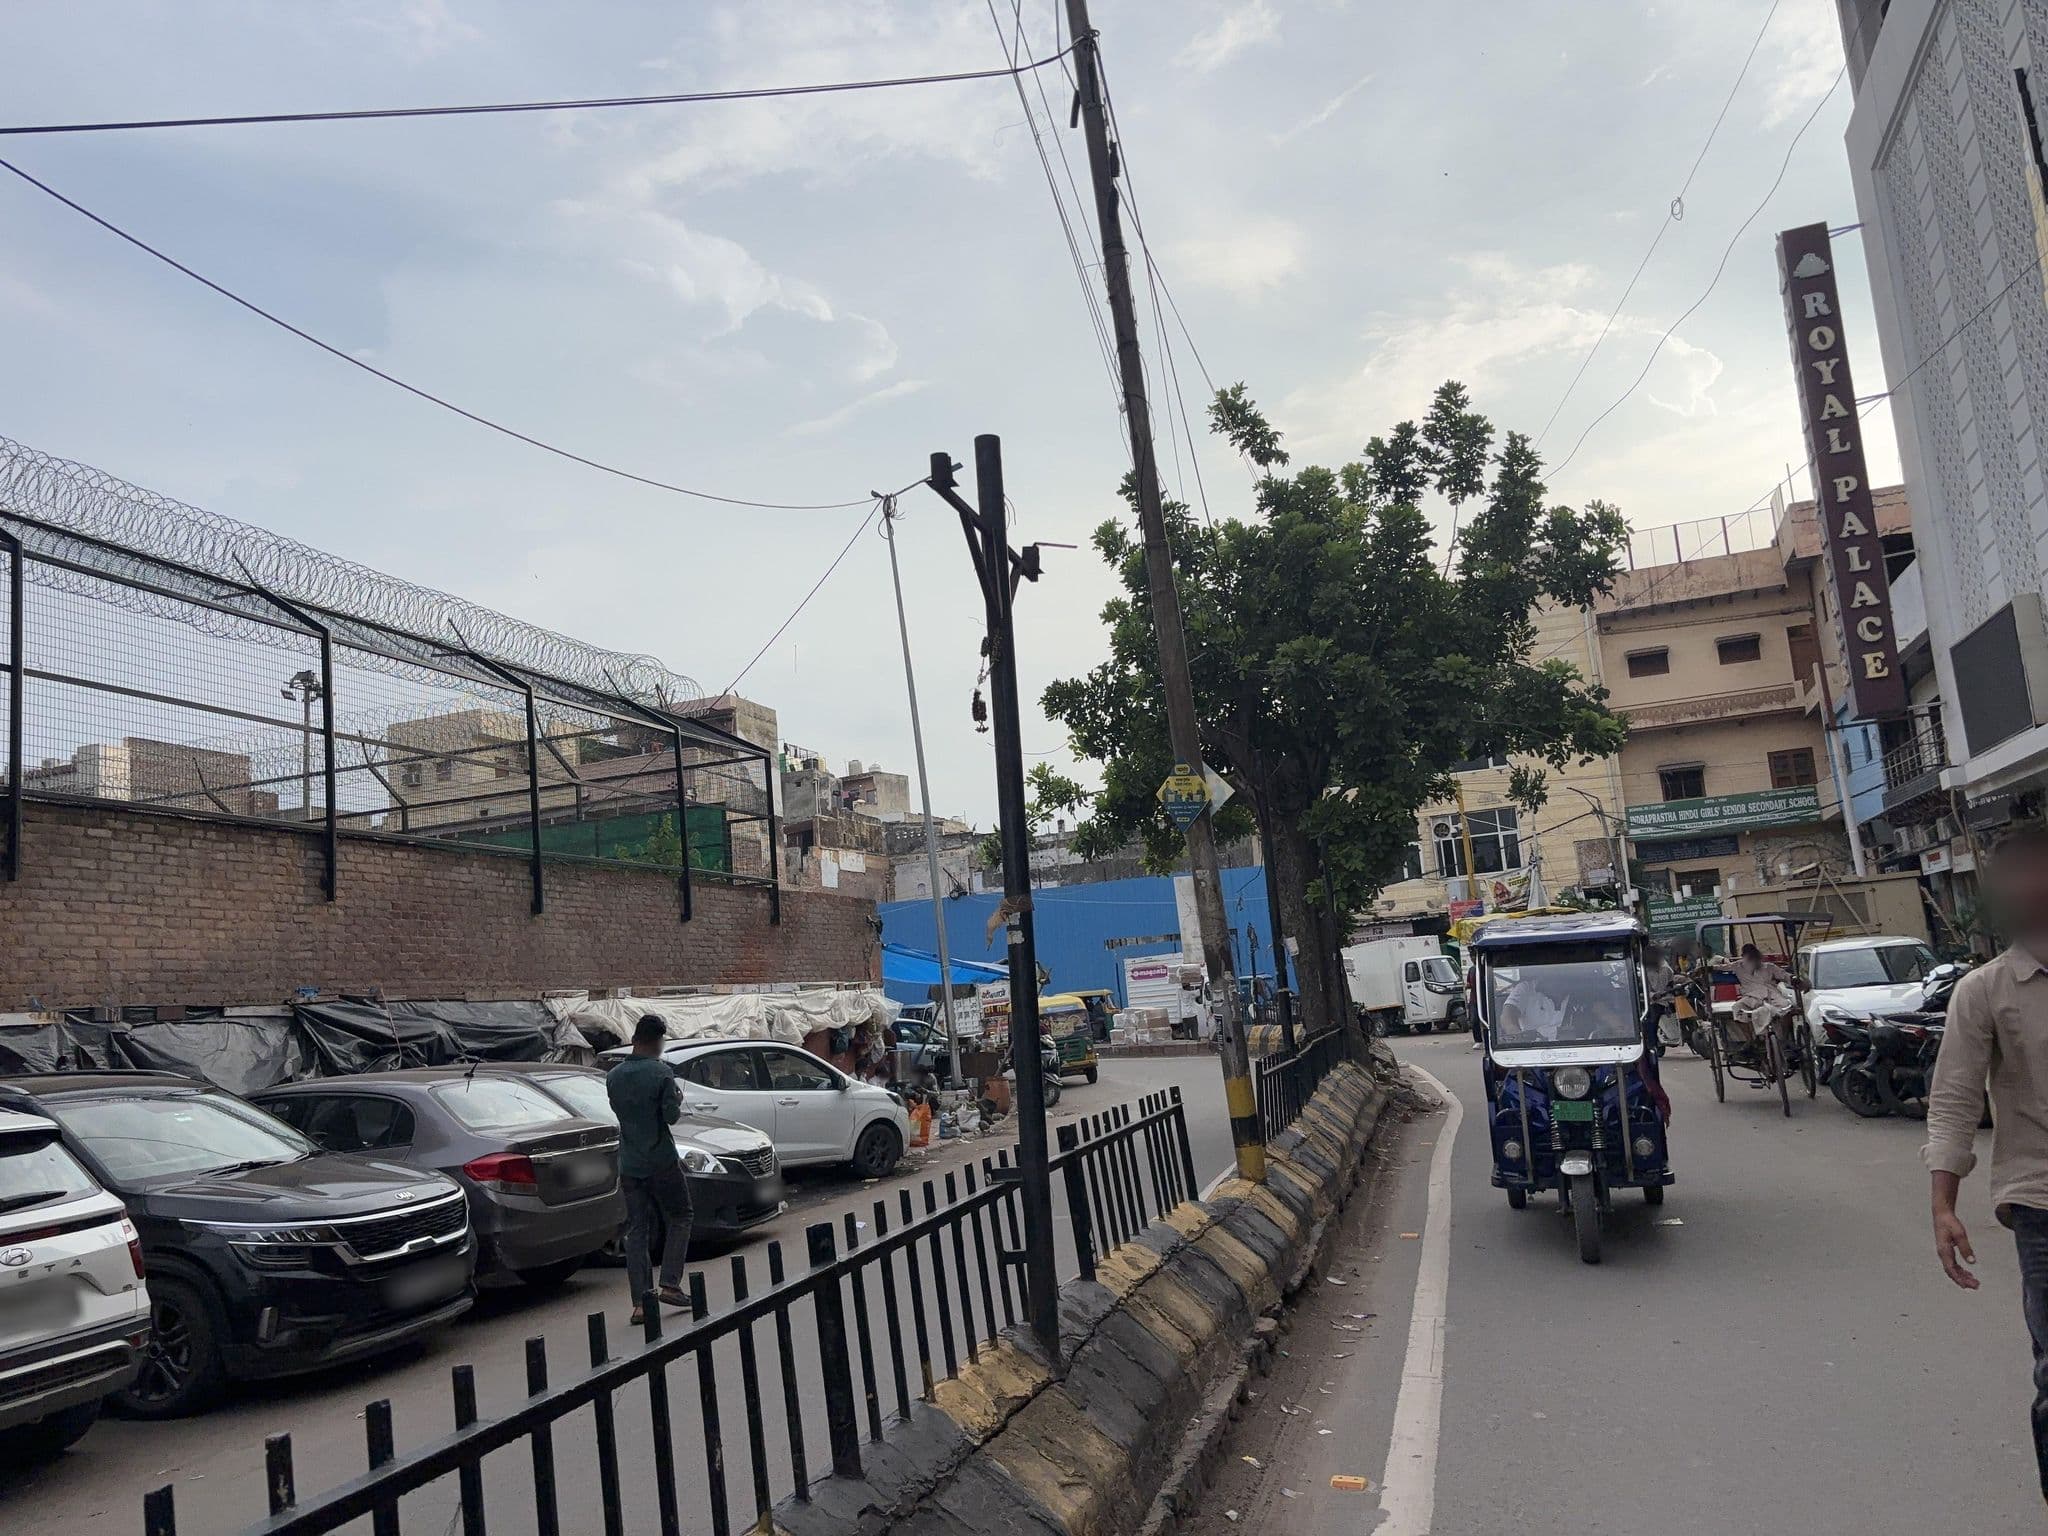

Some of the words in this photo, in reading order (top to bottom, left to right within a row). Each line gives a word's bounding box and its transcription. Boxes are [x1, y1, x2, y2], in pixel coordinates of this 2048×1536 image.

[1801, 291, 1851, 455] ROYAL
[1832, 475, 1890, 680] PALACE
[1629, 811, 1677, 825] INDRAPRASTHA
[1679, 809, 1699, 820] HINDU
[1722, 804, 1747, 816] SENIOR
[1748, 799, 1788, 813] SECONDARY
[1788, 795, 1817, 809] SCHOOL
